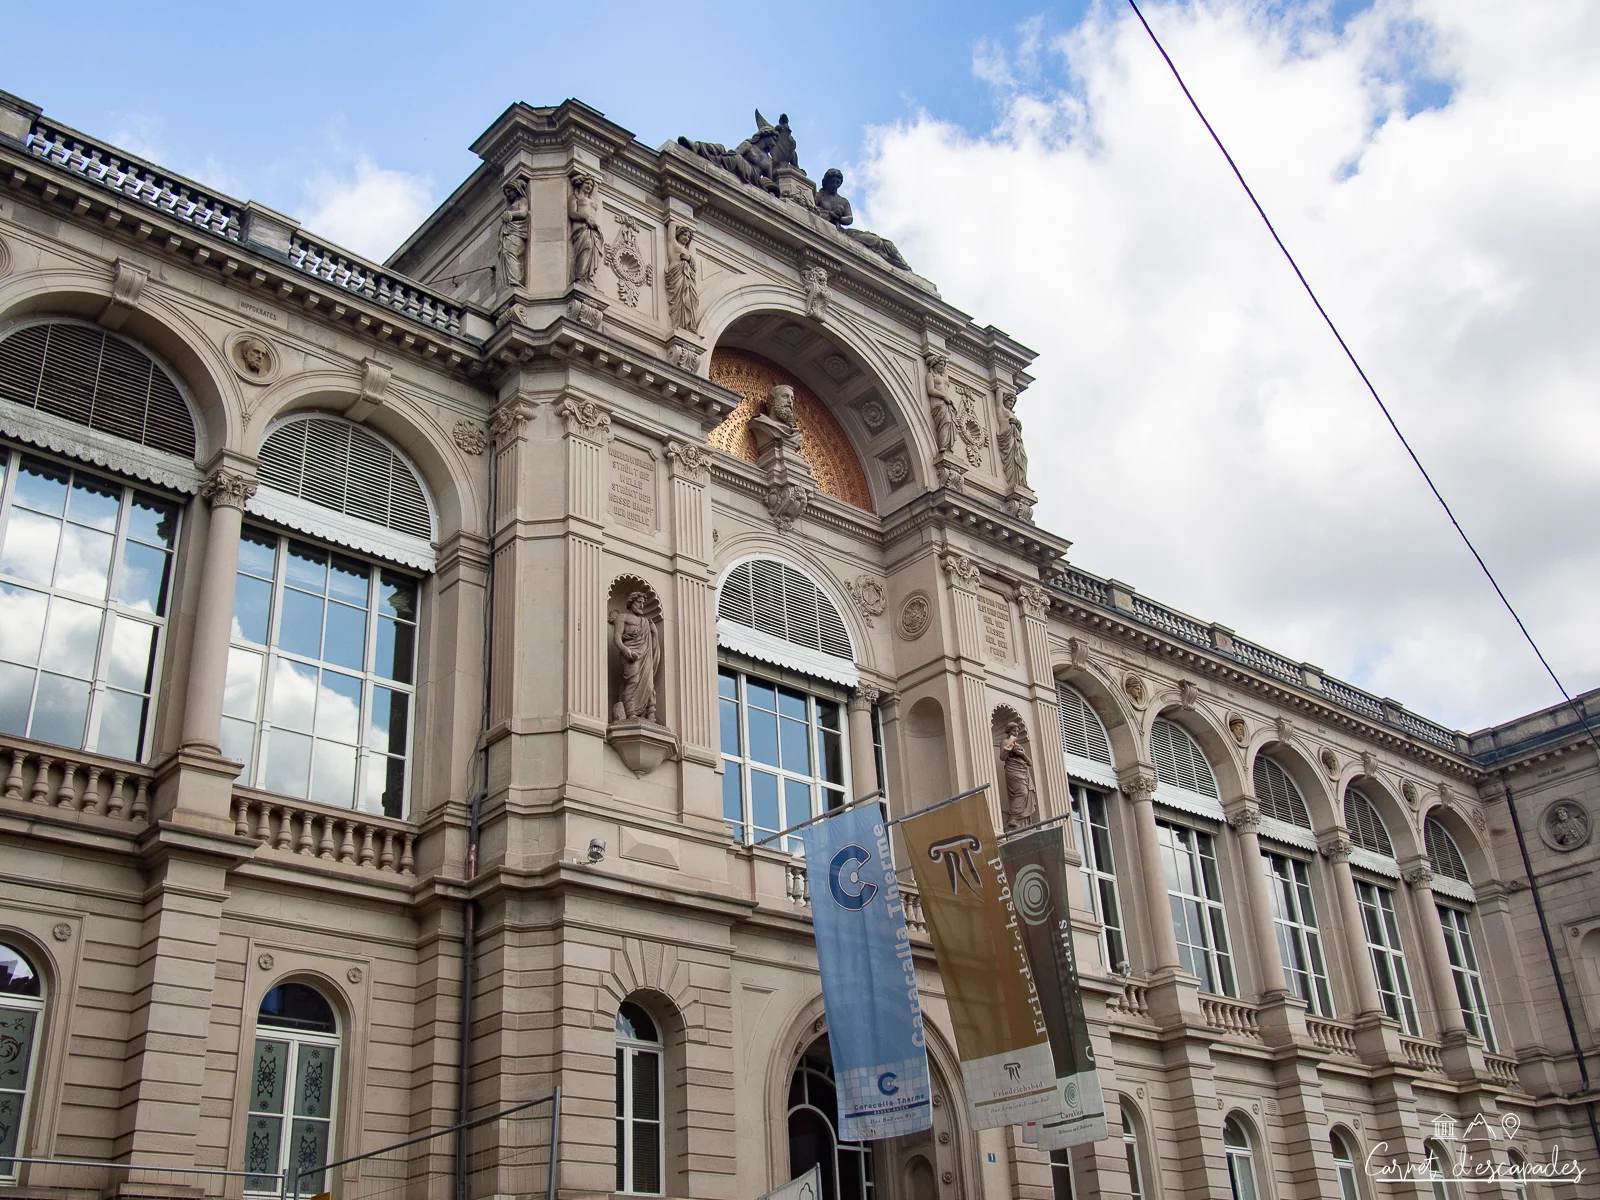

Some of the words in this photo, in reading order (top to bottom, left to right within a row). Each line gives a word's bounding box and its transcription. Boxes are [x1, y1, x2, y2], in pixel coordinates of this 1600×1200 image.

[241, 300, 277, 321] HIPPOKRATES
[619, 473, 643, 491] WELLE
[626, 509, 650, 526] QUELLE
[873, 823, 902, 920] Therme
[895, 926, 925, 1048] Caracalla
[992, 1080, 1043, 1098] Friedrichsbad
[853, 1100, 894, 1111] Caracalla
[896, 1093, 925, 1104] Therme
